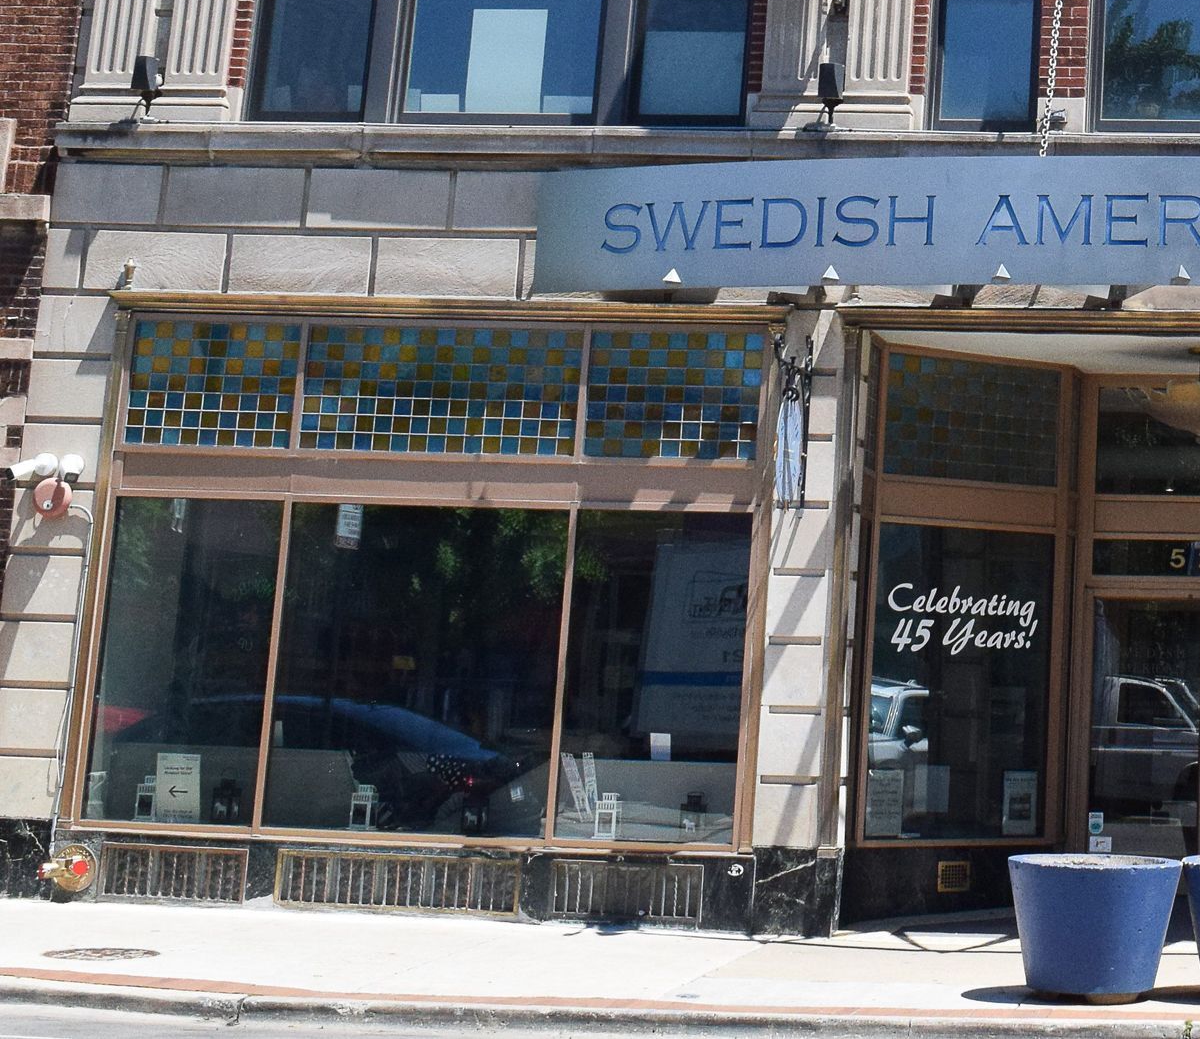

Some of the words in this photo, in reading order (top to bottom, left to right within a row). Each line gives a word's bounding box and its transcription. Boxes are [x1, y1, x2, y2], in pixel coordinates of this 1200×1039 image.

[601, 194, 936, 254] SWEDISH
[887, 583, 1036, 626] Celebrating
[890, 618, 934, 652] 45
[942, 617, 1038, 655] Years!
